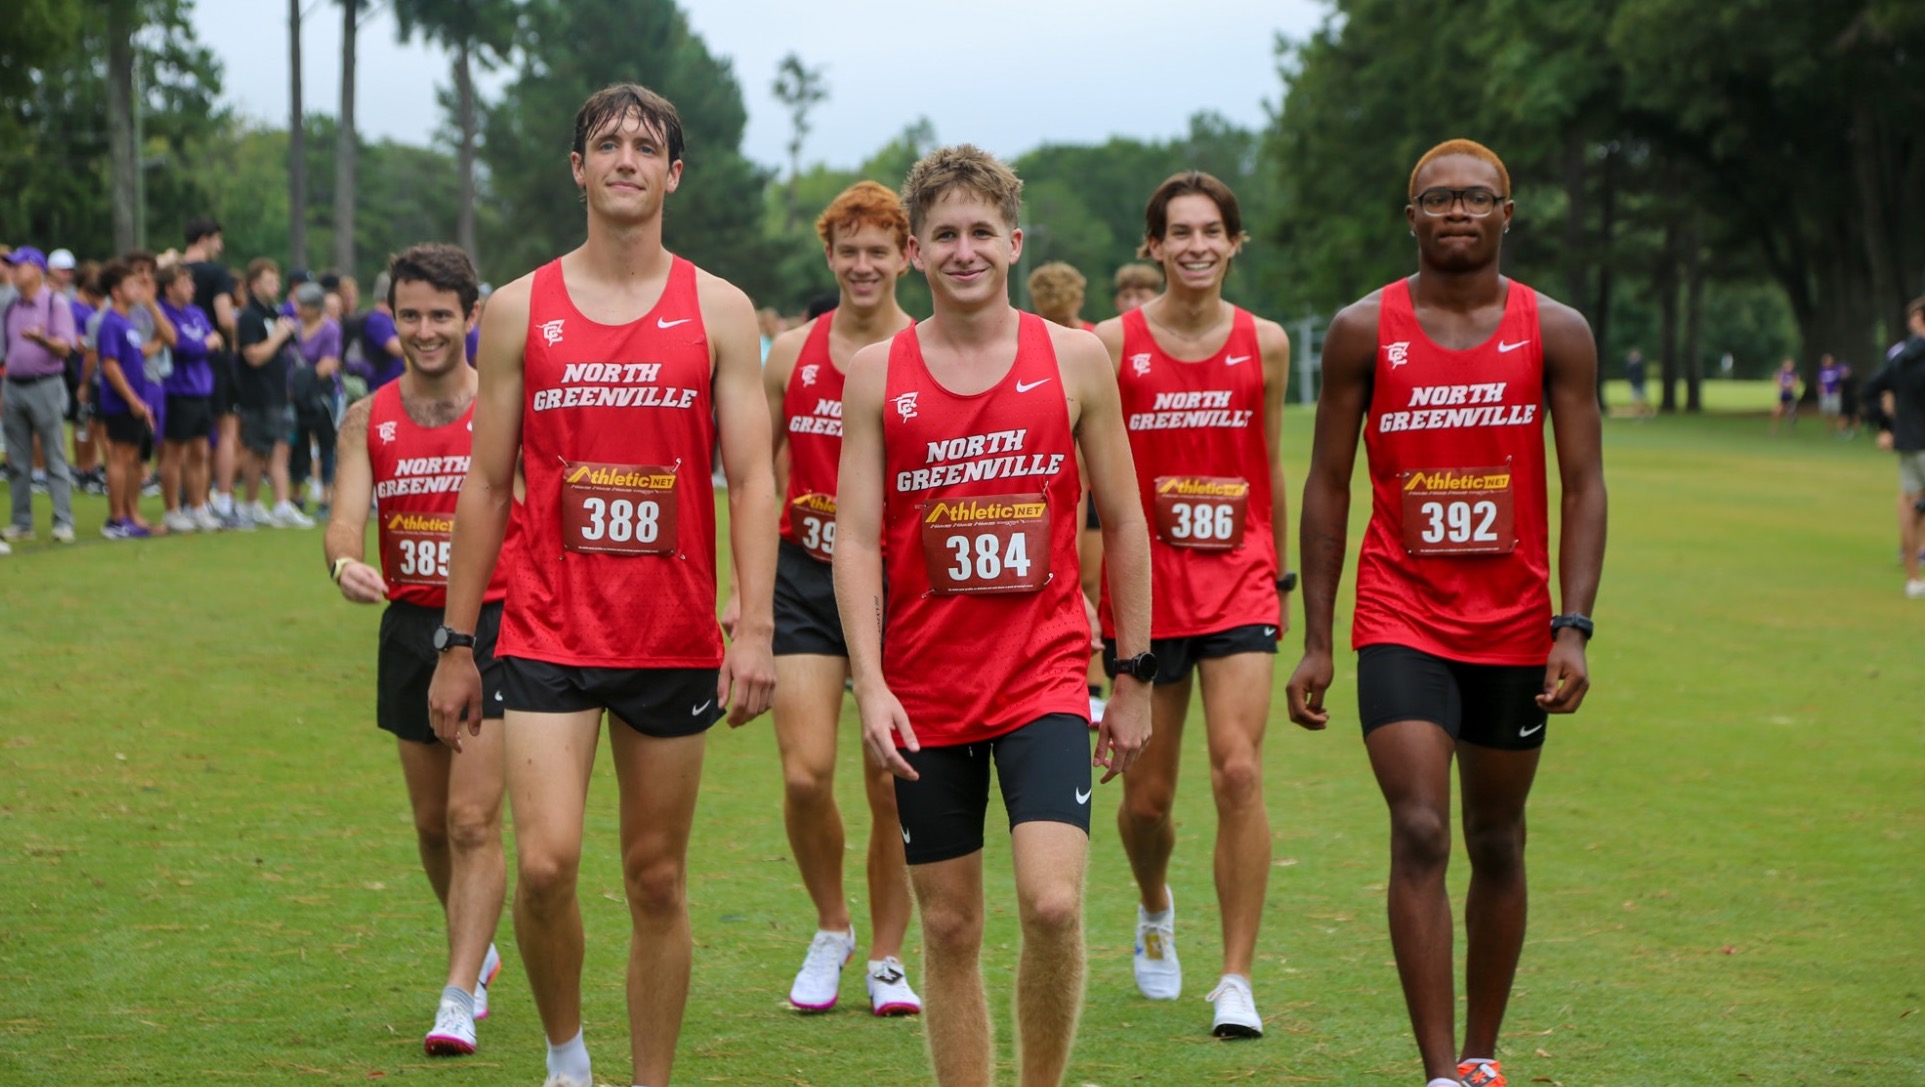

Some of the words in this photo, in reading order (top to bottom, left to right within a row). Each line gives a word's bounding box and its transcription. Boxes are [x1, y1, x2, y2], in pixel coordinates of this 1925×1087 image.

[561, 363, 661, 383] NORTH
[533, 386, 698, 412] GREENVILLE
[1153, 391, 1232, 410] NORTH
[1408, 382, 1507, 407] NORTH
[789, 415, 842, 437] GREE
[1379, 404, 1537, 433] GREENVILLE
[926, 429, 1027, 464] NORTH
[394, 456, 471, 476] NORTH
[566, 465, 650, 488] Athletic
[896, 454, 1065, 492] GREENVILLE
[377, 475, 466, 498] GREENVI
[1404, 471, 1484, 490] Athletic
[581, 497, 659, 543] 388
[925, 501, 1014, 523] Athletic
[1017, 506, 1041, 515] NET
[1171, 503, 1234, 540] 386
[1421, 501, 1498, 543] 392
[399, 539, 452, 577] 385
[946, 532, 1031, 581] 384
